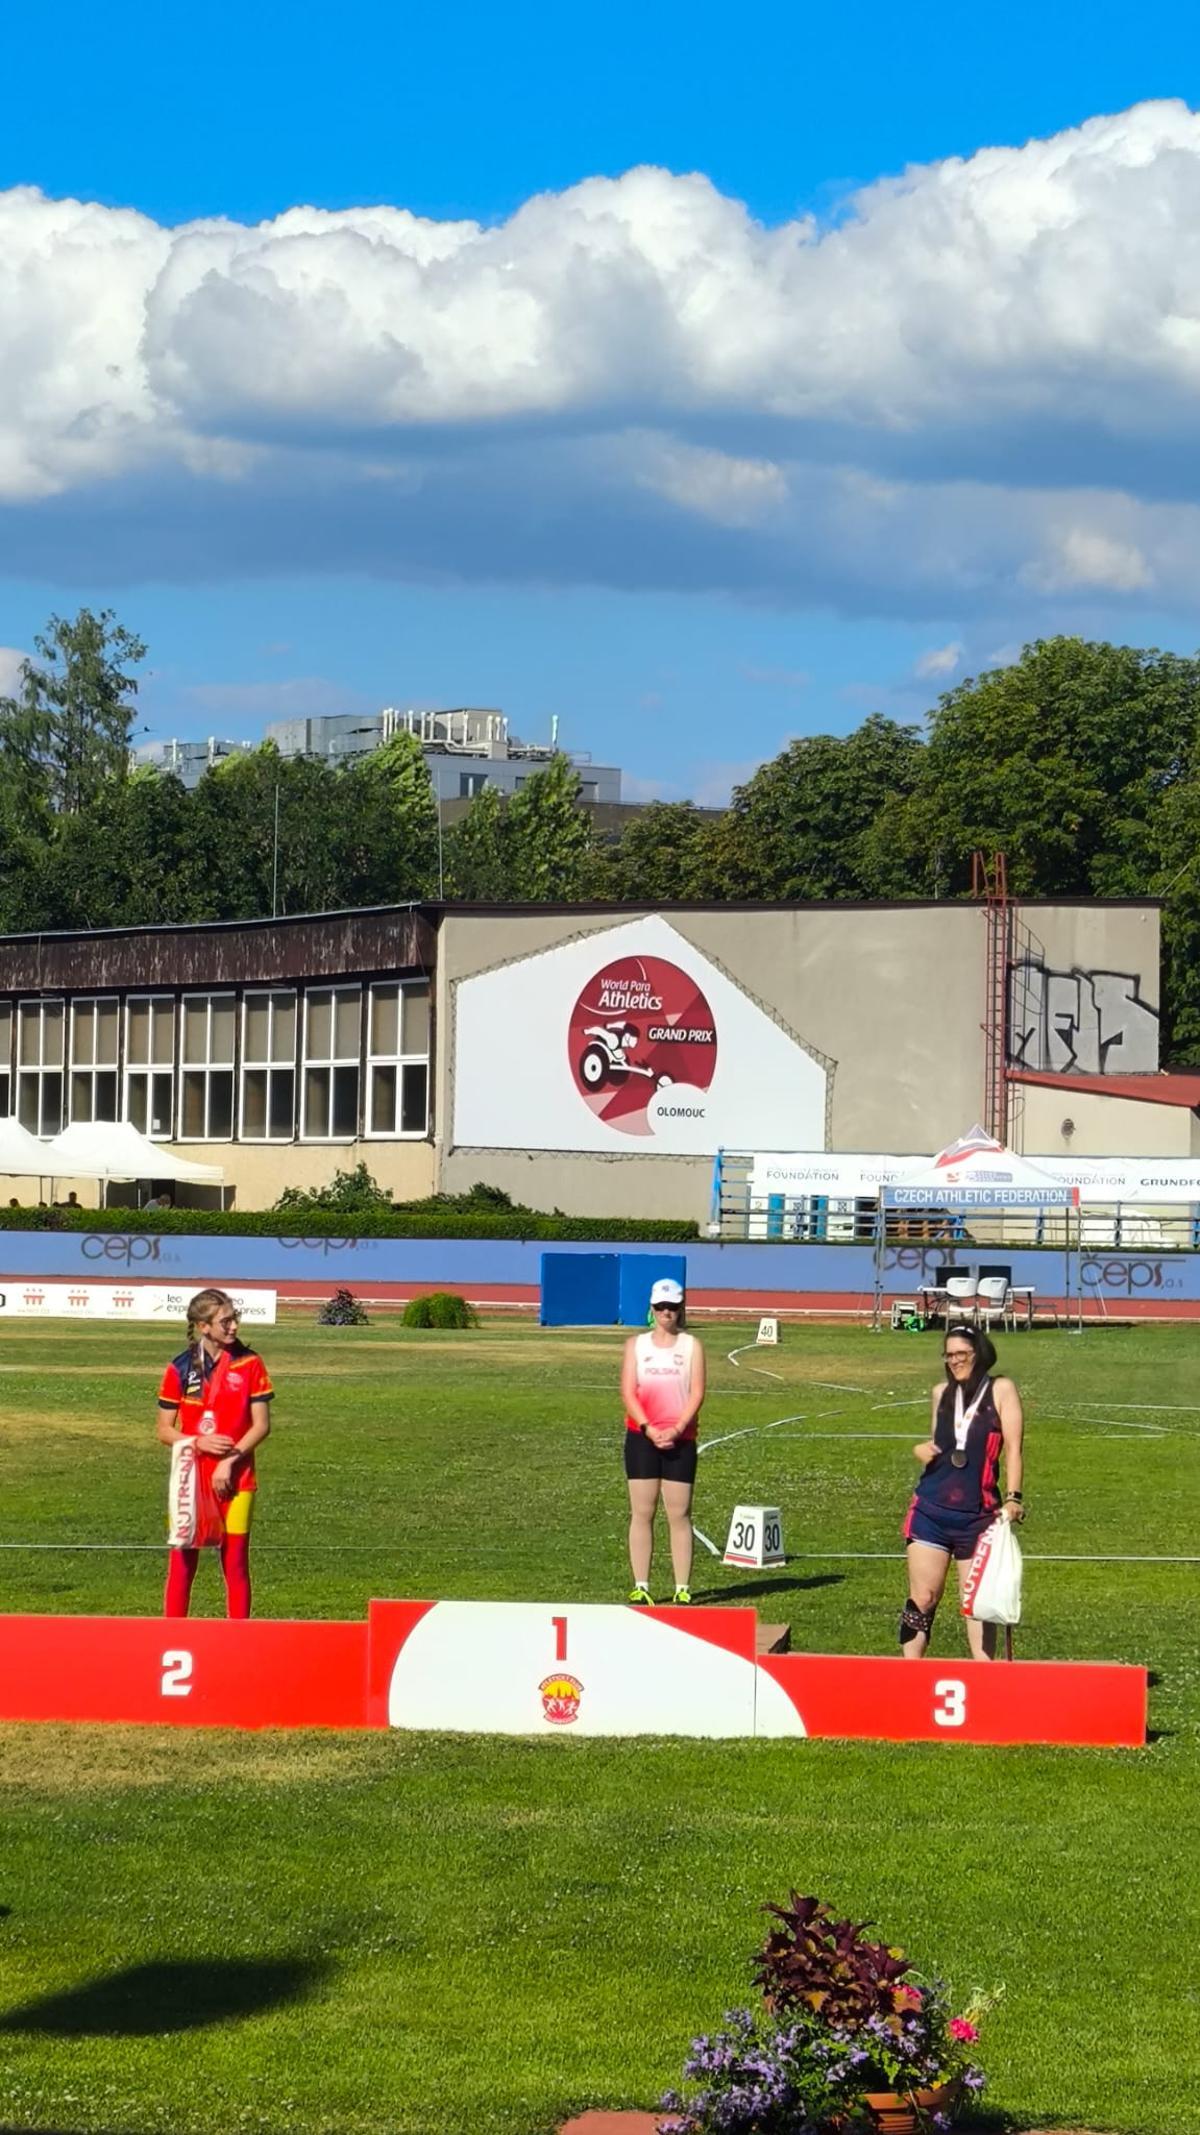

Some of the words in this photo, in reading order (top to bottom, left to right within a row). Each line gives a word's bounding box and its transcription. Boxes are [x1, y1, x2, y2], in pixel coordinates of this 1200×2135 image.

[601, 979, 627, 991] World
[630, 981, 650, 991] Para
[598, 991, 663, 1010] Athletics
[649, 1028, 686, 1041] GRAND
[688, 1029, 713, 1042] PRIX
[657, 1107, 705, 1118] OLOMOUC
[766, 1169, 839, 1181] FOUNDATION
[894, 1189, 933, 1203] CZECH
[936, 1189, 991, 1203] ATHLETIC
[994, 1189, 1067, 1204] FEDERATION
[167, 1294, 182, 1303] leo
[761, 1325, 773, 1338] 40
[733, 1522, 755, 1551] 30
[765, 1523, 780, 1552] 30
[552, 1616, 567, 1661] 1
[161, 1650, 193, 1696] 2
[934, 1680, 966, 1726] 3
